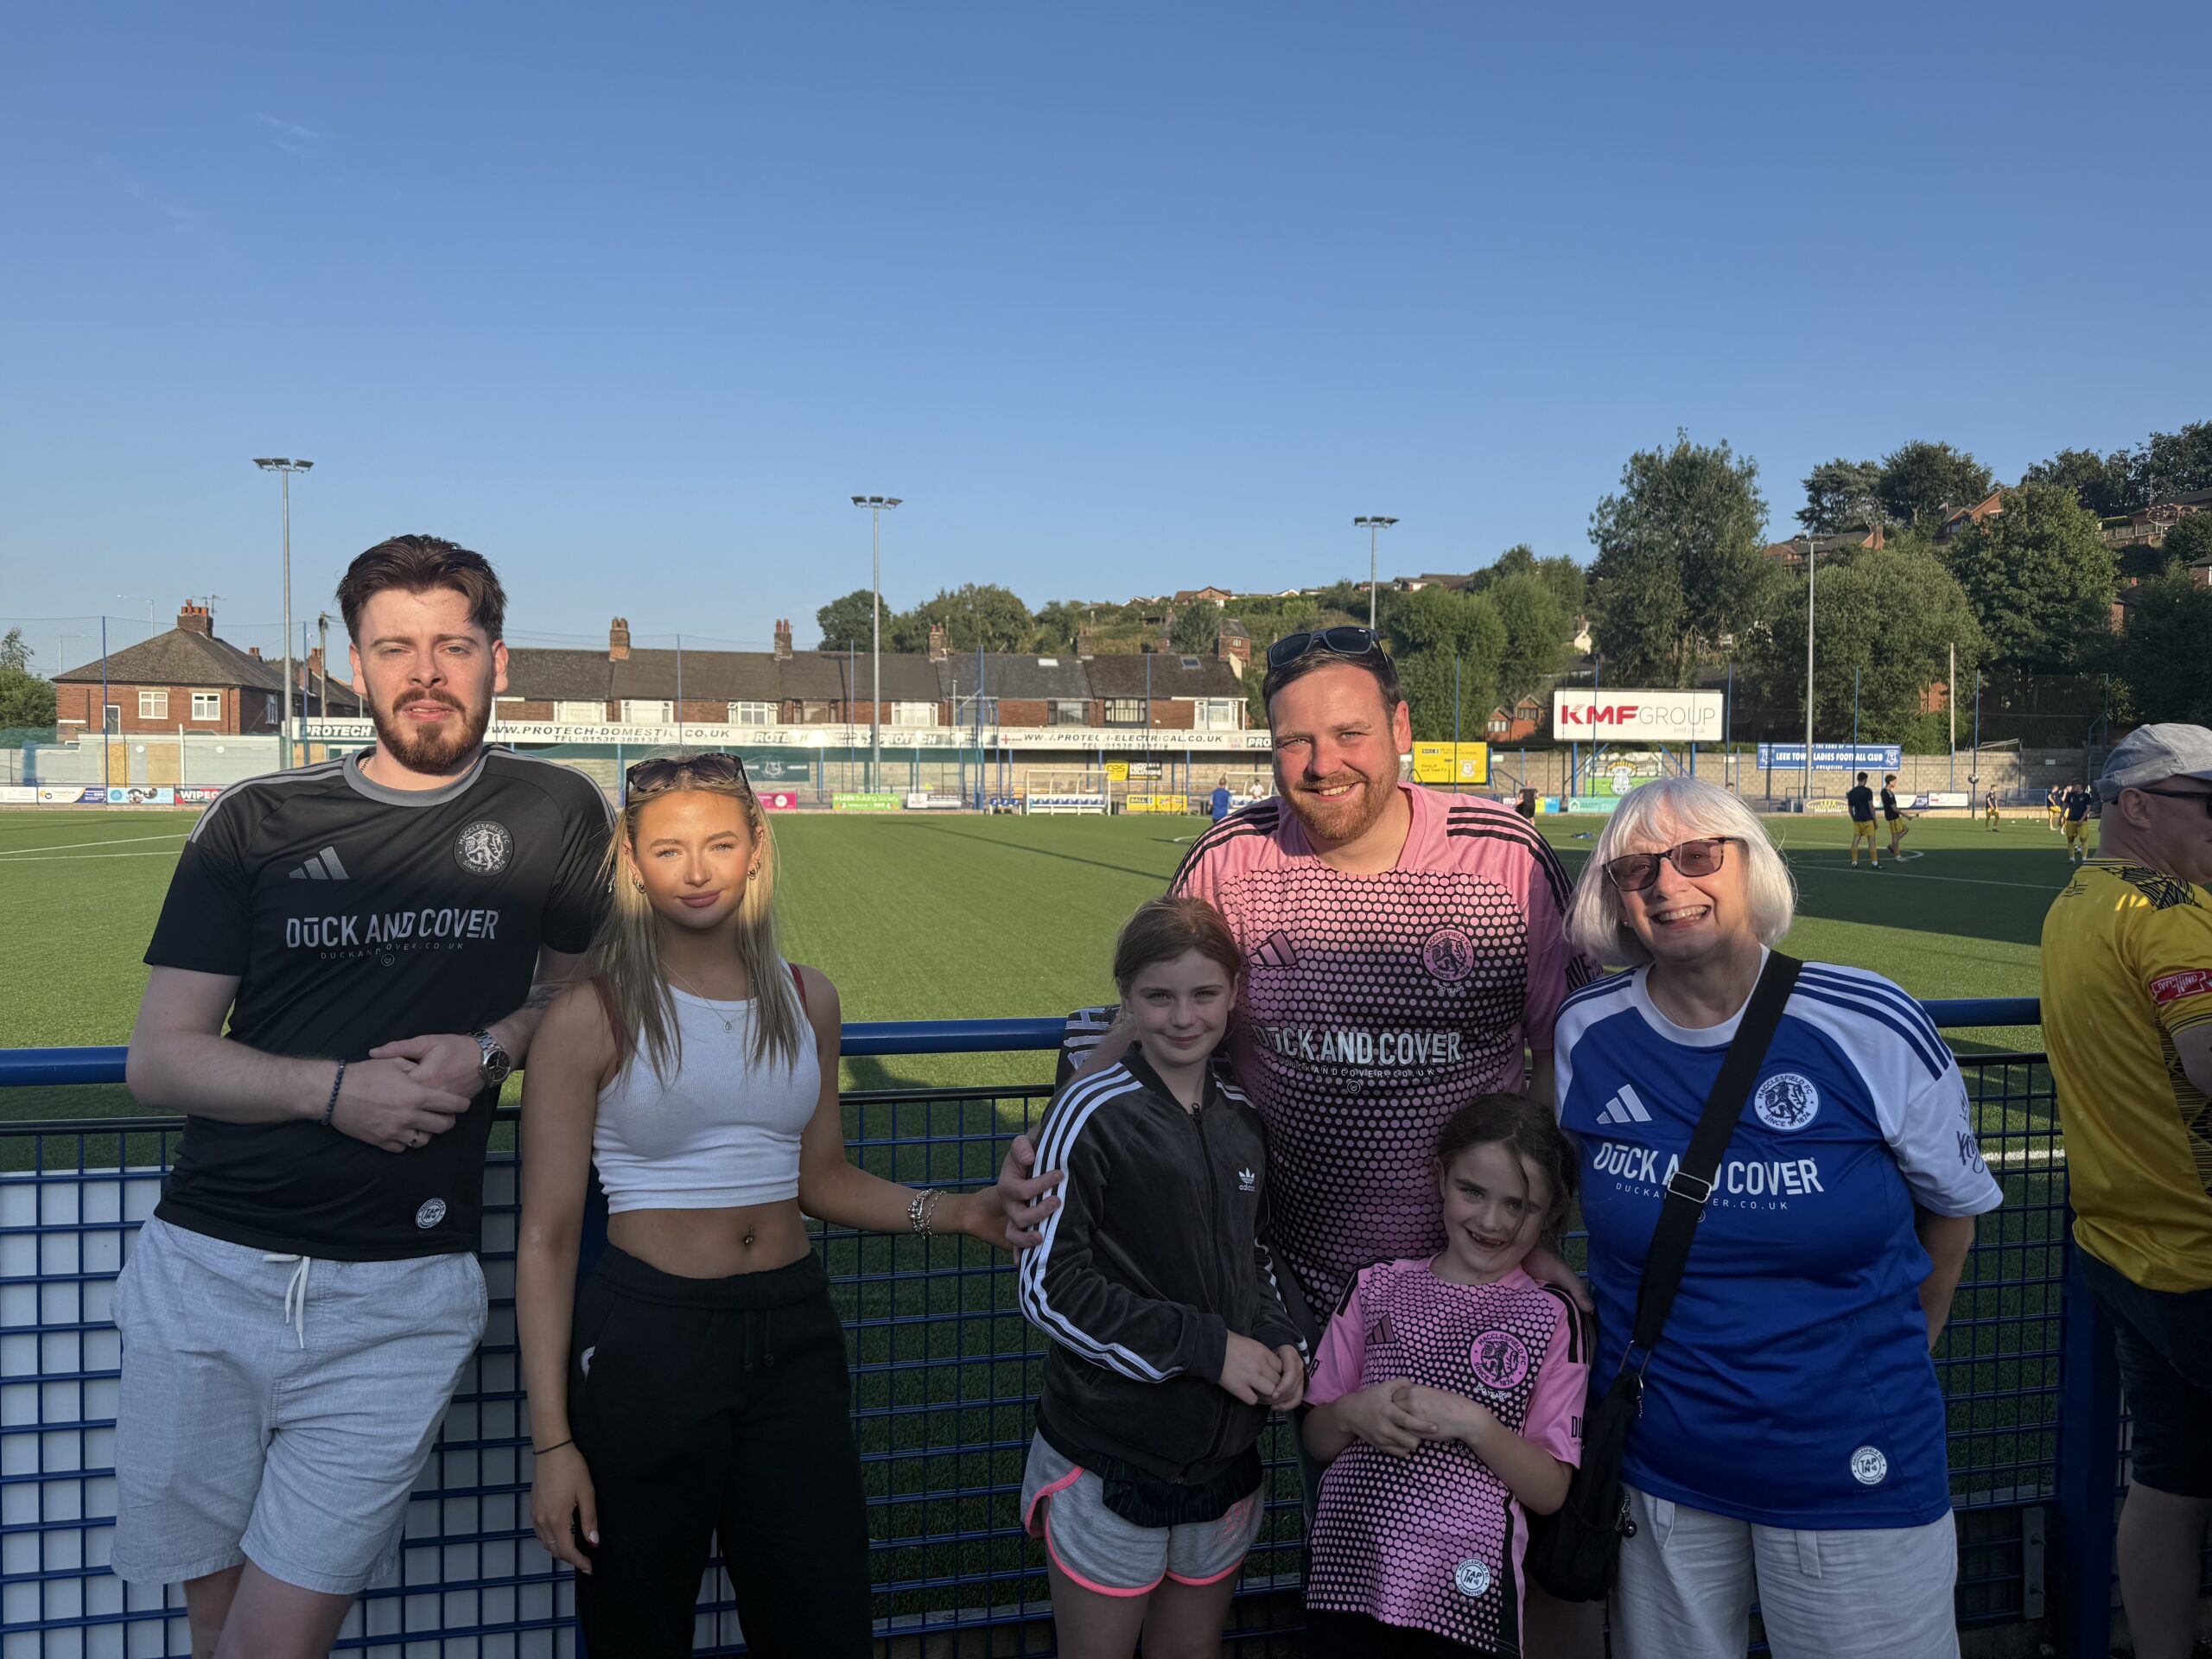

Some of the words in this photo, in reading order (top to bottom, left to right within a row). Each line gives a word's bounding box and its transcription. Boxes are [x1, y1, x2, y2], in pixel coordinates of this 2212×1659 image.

[1776, 753, 1790, 761] LEEK
[1792, 753, 1806, 761] TOW
[1814, 753, 1834, 762] LADIES
[1867, 753, 1883, 762] CLUB
[459, 823, 504, 845] MACCLESFIELD
[502, 835, 510, 844] FC
[462, 860, 482, 872] SINCE
[493, 860, 505, 870] 1874
[365, 912, 416, 943] AND
[418, 908, 499, 939] COVER
[1425, 931, 1465, 953] MACCLESFIELD
[1464, 942, 1471, 950] FC
[1432, 968, 1451, 979] SINCE
[1446, 985, 1465, 994] YEARS
[1320, 1030, 1373, 1065] AND
[1379, 1031, 1465, 1065] COVER
[1758, 1074, 1805, 1100] MACCLESFIELD
[1803, 1082, 1814, 1094] FC
[1764, 1113, 1786, 1127] SINCE
[1796, 1111, 1812, 1126] 1874
[1727, 1158, 1825, 1197] COVER
[1478, 1333, 1524, 1354] MACCLESFIELD
[1519, 1356, 1527, 1365] FC
[1474, 1362, 1491, 1382] SINCE
[1500, 1378, 1514, 1387] 1874
[1488, 1390, 1508, 1399] YEARS
[1459, 1560, 1487, 1572] MACCLESFIELD
